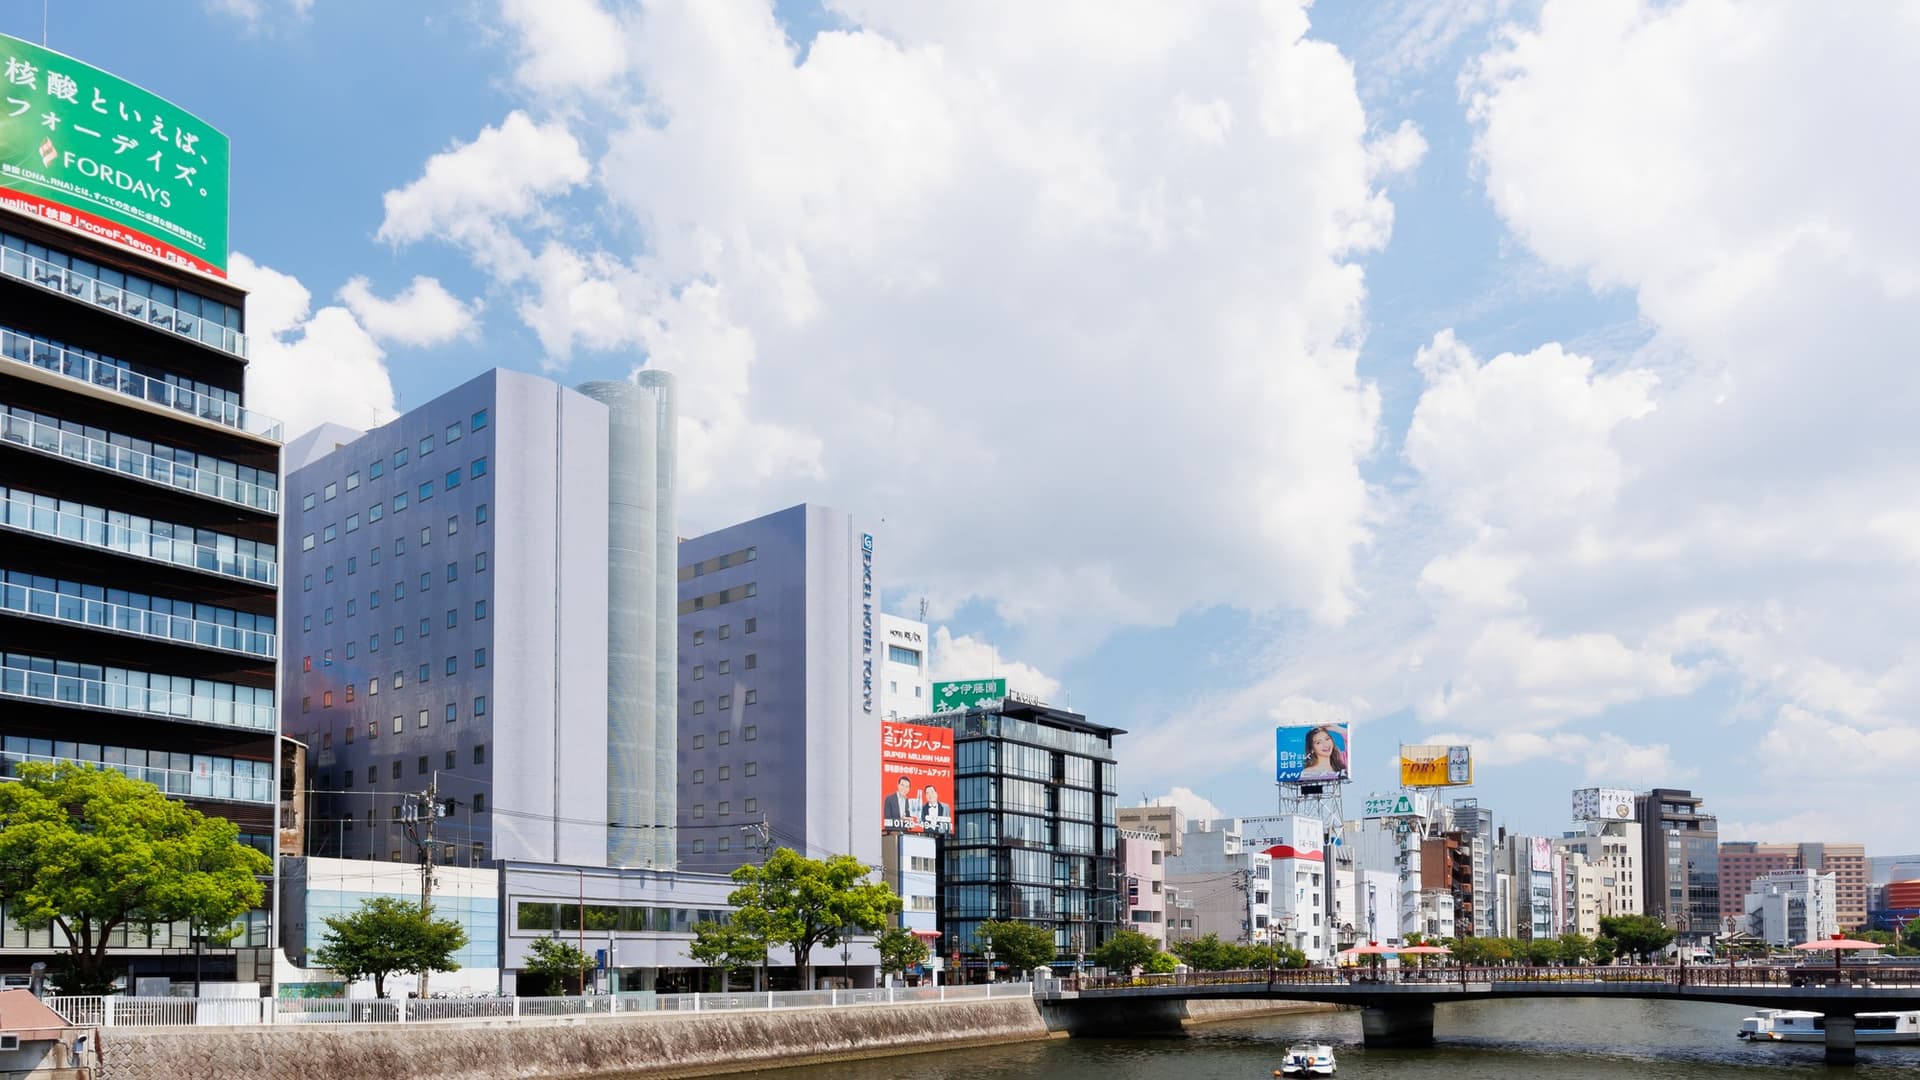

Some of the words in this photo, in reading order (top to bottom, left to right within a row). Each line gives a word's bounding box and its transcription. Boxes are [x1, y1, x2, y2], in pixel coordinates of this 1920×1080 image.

[5, 56, 208, 164] 核酸といえば、
[63, 151, 171, 208] FORDAYS
[862, 552, 872, 598] EXCEL
[862, 603, 872, 654] HOTEL
[862, 657, 872, 714] TOKYU
[960, 682, 997, 695] 伊藤園
[884, 725, 923, 739] スーパー
[884, 736, 951, 752] ミリオンヘアー
[884, 750, 907, 759] SUPER
[908, 753, 934, 762] MILLION
[934, 755, 951, 763] HAIR
[1410, 762, 1437, 773] DRY
[1366, 799, 1392, 807] ウチヤマ
[1366, 806, 1392, 814] グループ
